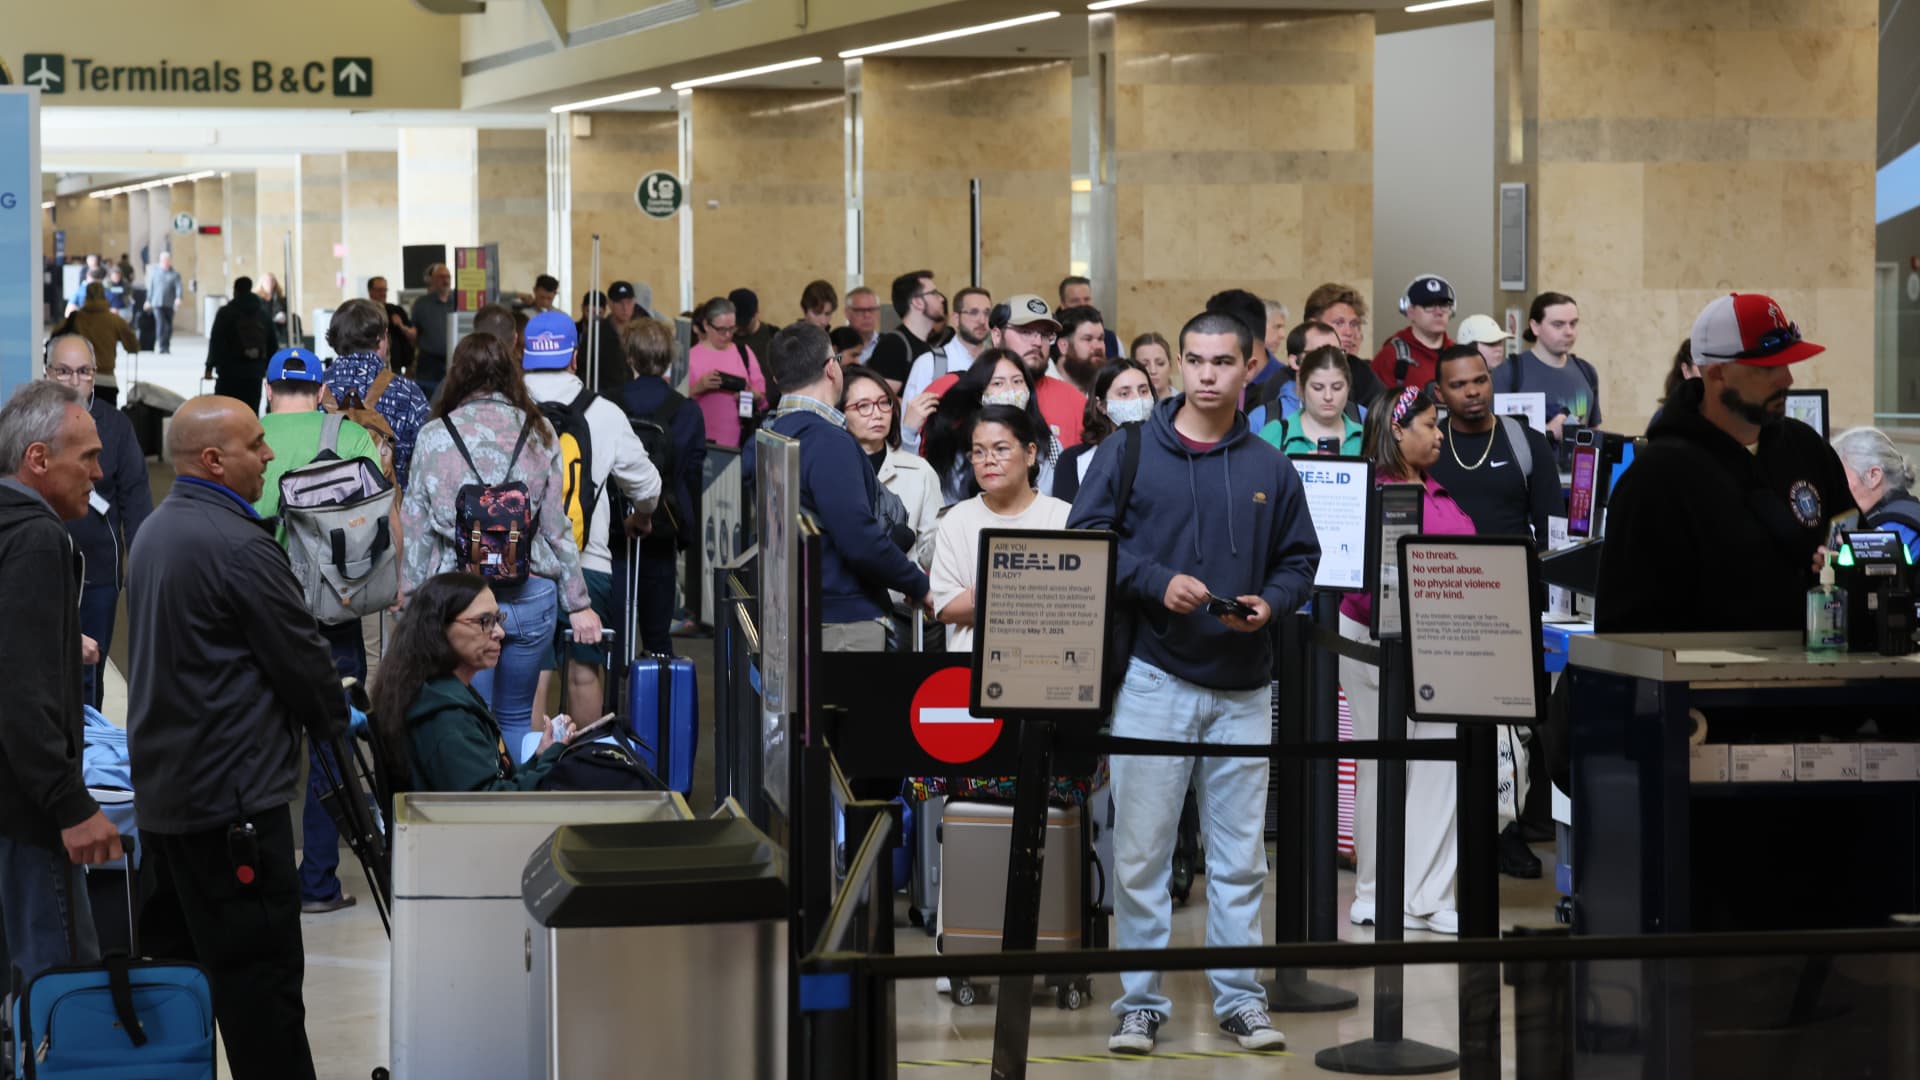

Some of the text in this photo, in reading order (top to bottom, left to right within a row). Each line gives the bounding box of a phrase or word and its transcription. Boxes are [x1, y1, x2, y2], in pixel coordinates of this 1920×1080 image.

[72, 59, 240, 93] Terminals
[1336, 472, 1351, 485] ID
[994, 543, 1027, 551] ARE YOU
[1411, 550, 1459, 560] No threats.
[993, 552, 1081, 571] REAL ID
[1412, 564, 1484, 575] No verbal abuse.
[992, 571, 1022, 579] READY?
[1413, 578, 1501, 590] No physical violence
[1414, 590, 1464, 600] of any kind.
[1027, 627, 1041, 635] May
[1780, 767, 1793, 778] XL
[1840, 767, 1858, 777] XXL
